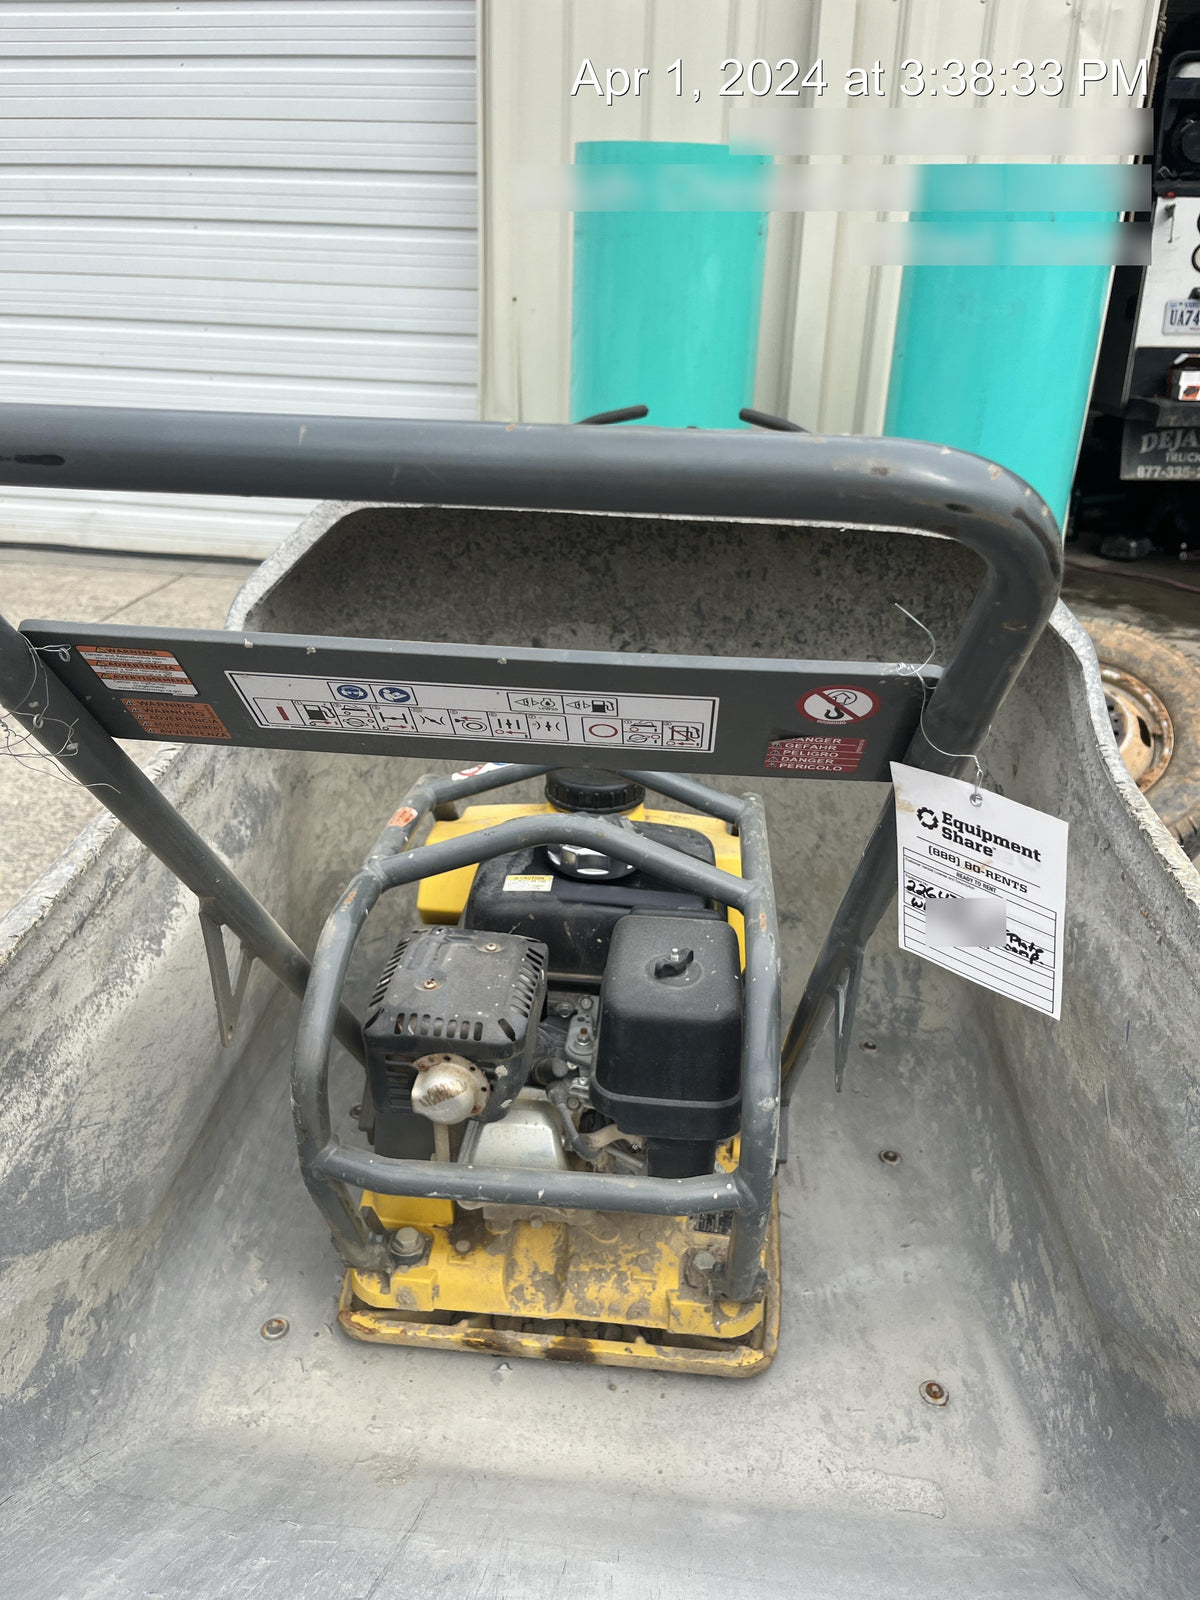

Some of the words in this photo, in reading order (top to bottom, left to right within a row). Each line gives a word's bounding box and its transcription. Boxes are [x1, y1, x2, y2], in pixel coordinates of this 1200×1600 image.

[106, 647, 157, 656] WARNING
[136, 700, 195, 709] WARNING
[784, 742, 838, 751] GEFAHR
[782, 749, 839, 758] PELIGRO
[781, 756, 834, 765] DANGER
[778, 763, 843, 772] PERICOLO
[942, 811, 1042, 863] Equipment
[942, 826, 993, 857] Share
[928, 845, 961, 867] (888)
